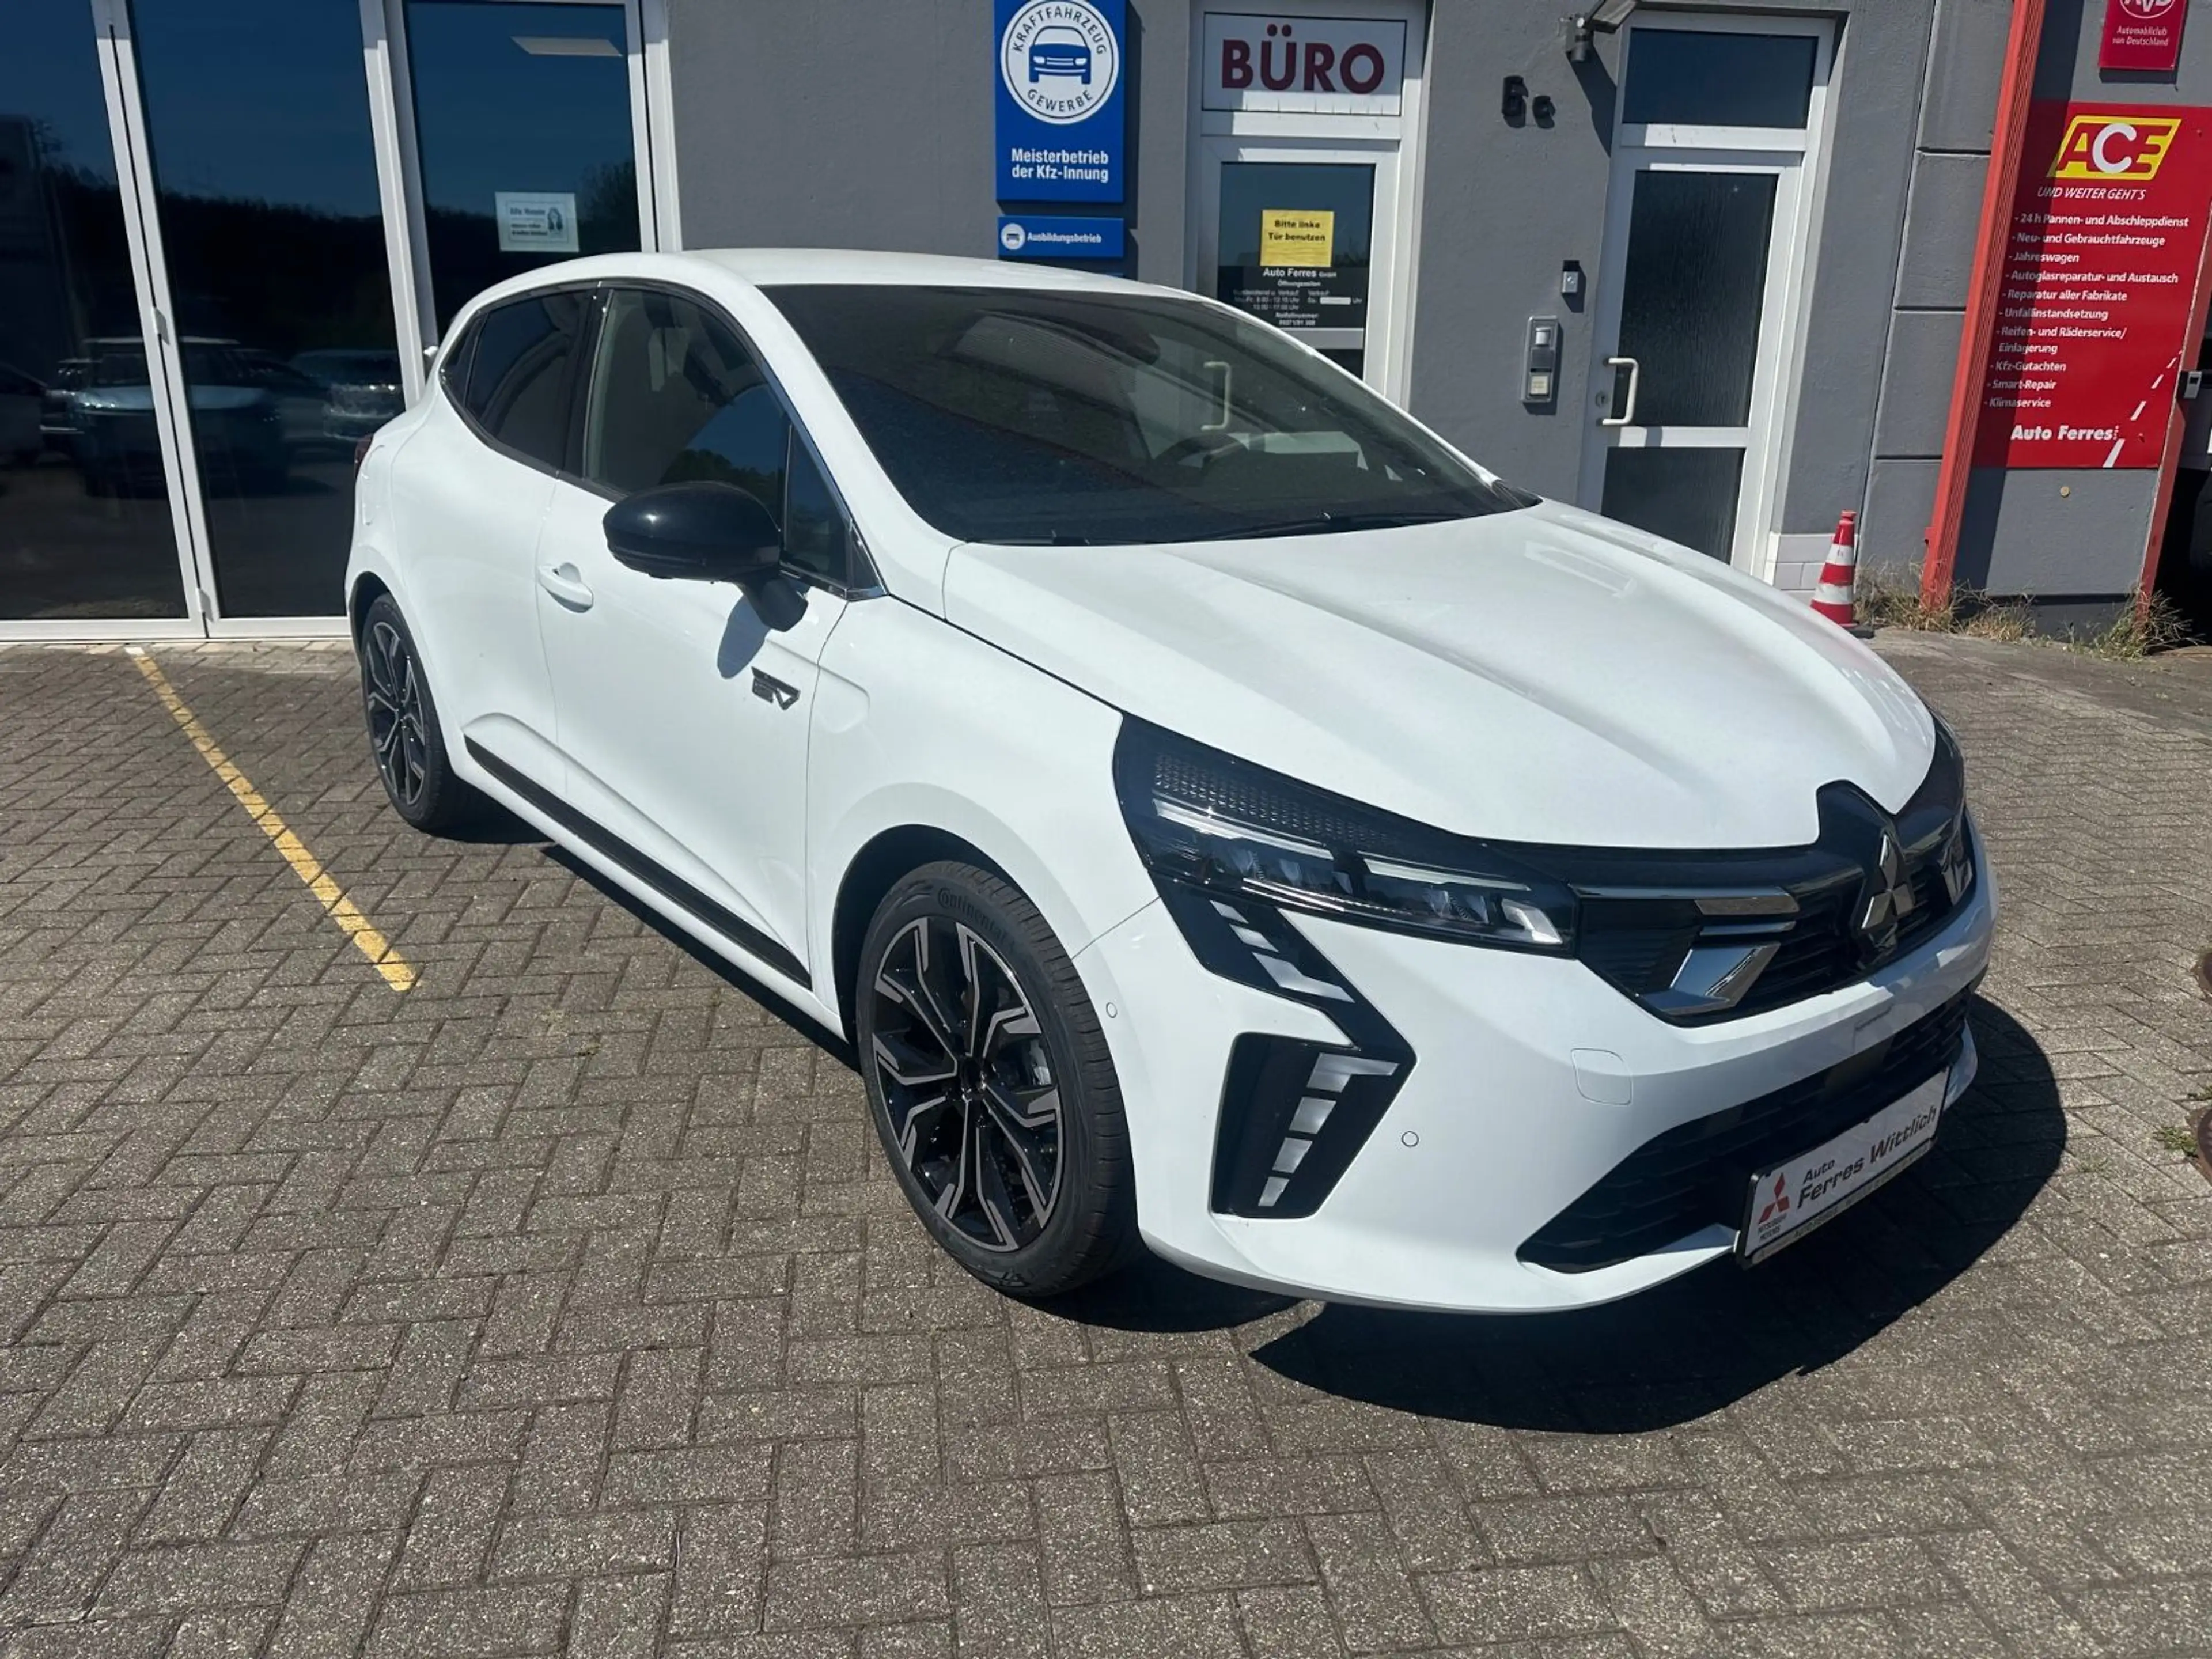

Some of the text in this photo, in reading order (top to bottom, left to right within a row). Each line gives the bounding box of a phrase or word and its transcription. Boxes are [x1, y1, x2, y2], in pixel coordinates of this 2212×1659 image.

[1013, 6, 1107, 55] KRAFTFAHRZEUG
[2126, 36, 2169, 46] Deutschland
[1222, 24, 1384, 94] BÜRO
[1027, 89, 1093, 112] GEWERBE
[2055, 122, 2174, 175] ACE
[1012, 147, 1109, 164] Meisterbetrieb
[1012, 164, 1108, 183] der Kfz-Innung
[2037, 187, 2062, 198] UND
[2065, 188, 2105, 199] WEITER
[2021, 214, 2188, 228] 24 h Pannen- und Abschleppdienst
[2017, 233, 2165, 247] Neu- und Gebrauchtfahrzeuge
[2013, 251, 2080, 264] Jahreswagen
[1263, 268, 1285, 276] Auto
[2011, 271, 2178, 283] Autoglasreparatur- und Austausch
[2008, 290, 2127, 301] Reparatur aller Fabrikate
[2005, 308, 2108, 321] Unfallinstandsetzung
[2002, 327, 2127, 338] Reifen- und Räderservice/
[1999, 343, 2058, 354] Einlagerung
[1995, 361, 2067, 371] Kfz-Gutachten
[1992, 379, 2056, 391] Smart-Repair
[1989, 397, 2051, 407] Klimaservice
[2010, 424, 2052, 440] Auto
[2057, 424, 2113, 440] Ferres
[1797, 1157, 1865, 1209] Ferres
[1870, 1105, 1937, 1164] Wittlich
[1804, 1158, 1835, 1184] Auto
